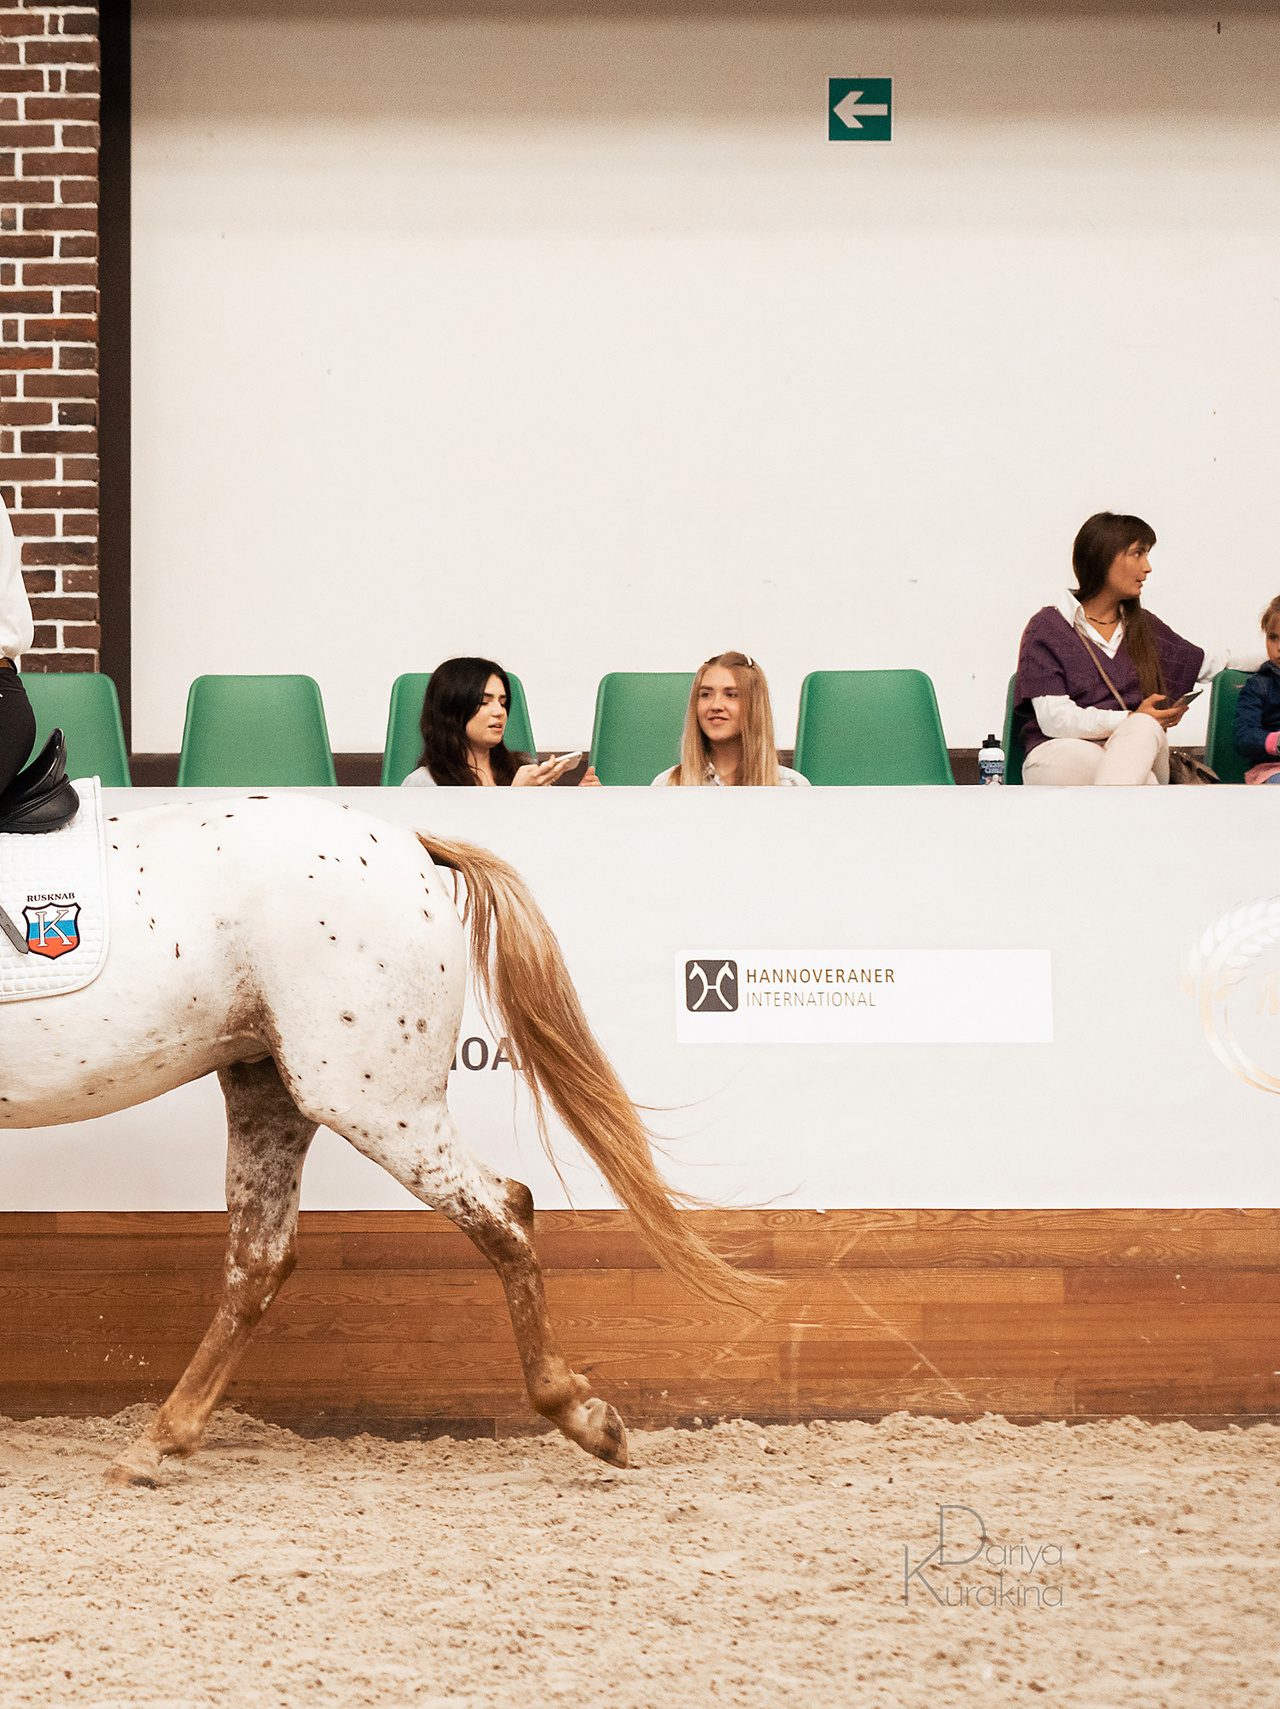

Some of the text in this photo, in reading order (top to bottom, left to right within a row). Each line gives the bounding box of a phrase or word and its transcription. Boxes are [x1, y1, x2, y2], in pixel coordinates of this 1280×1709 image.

[27, 892, 75, 902] RUSKNAB
[35, 909, 73, 947] K
[746, 968, 895, 984] HANNOVERANER
[746, 991, 876, 1007] INTERNATIONAL
